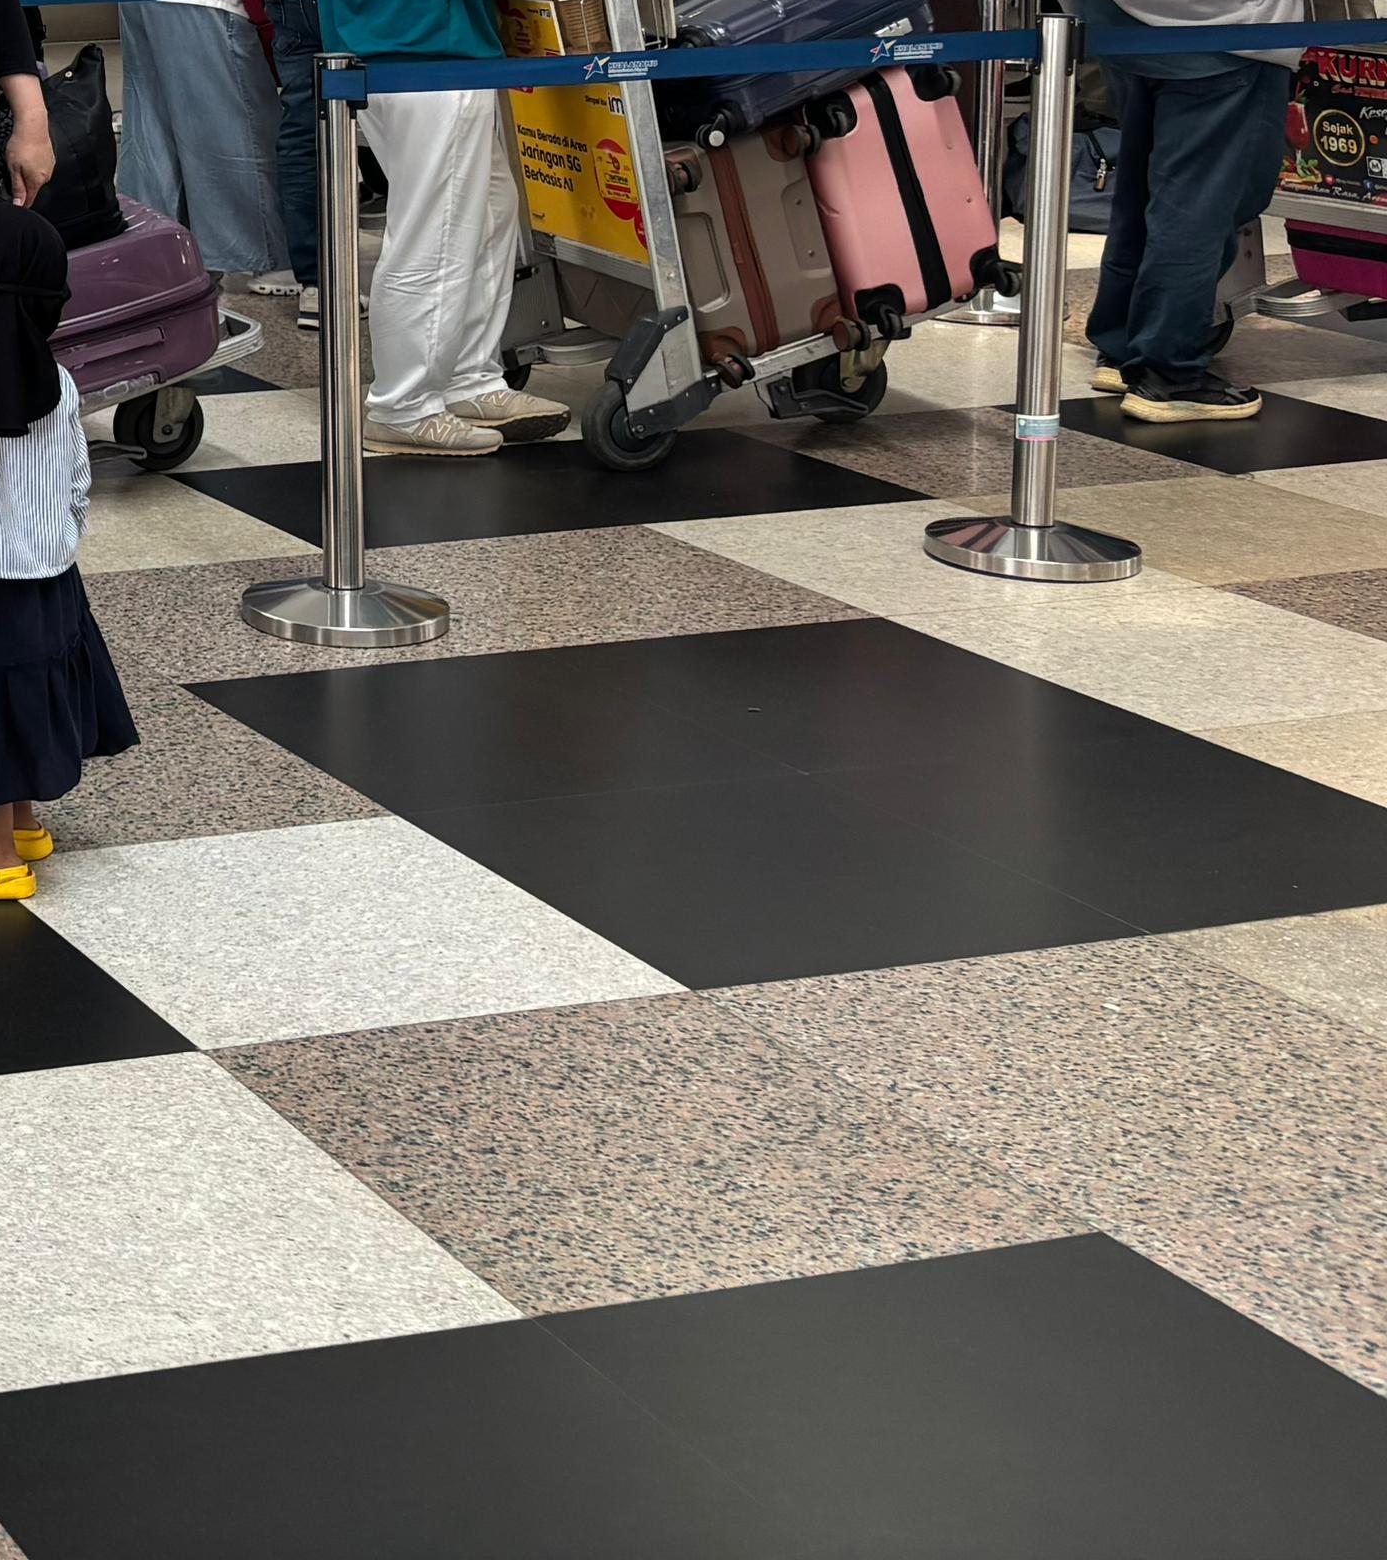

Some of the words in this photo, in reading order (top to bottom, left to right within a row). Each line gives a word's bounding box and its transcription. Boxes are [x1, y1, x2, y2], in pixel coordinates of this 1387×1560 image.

[1317, 50, 1387, 87] KURN
[1359, 106, 1387, 121] Kese
[517, 124, 537, 139] Kamu
[537, 128, 562, 146] Berada
[570, 138, 588, 153] Area
[1322, 121, 1354, 136] Sejak
[521, 142, 566, 169] Jaringan
[566, 153, 582, 173] 5G
[1321, 135, 1358, 155] 1969
[524, 164, 563, 189] Berbasis
